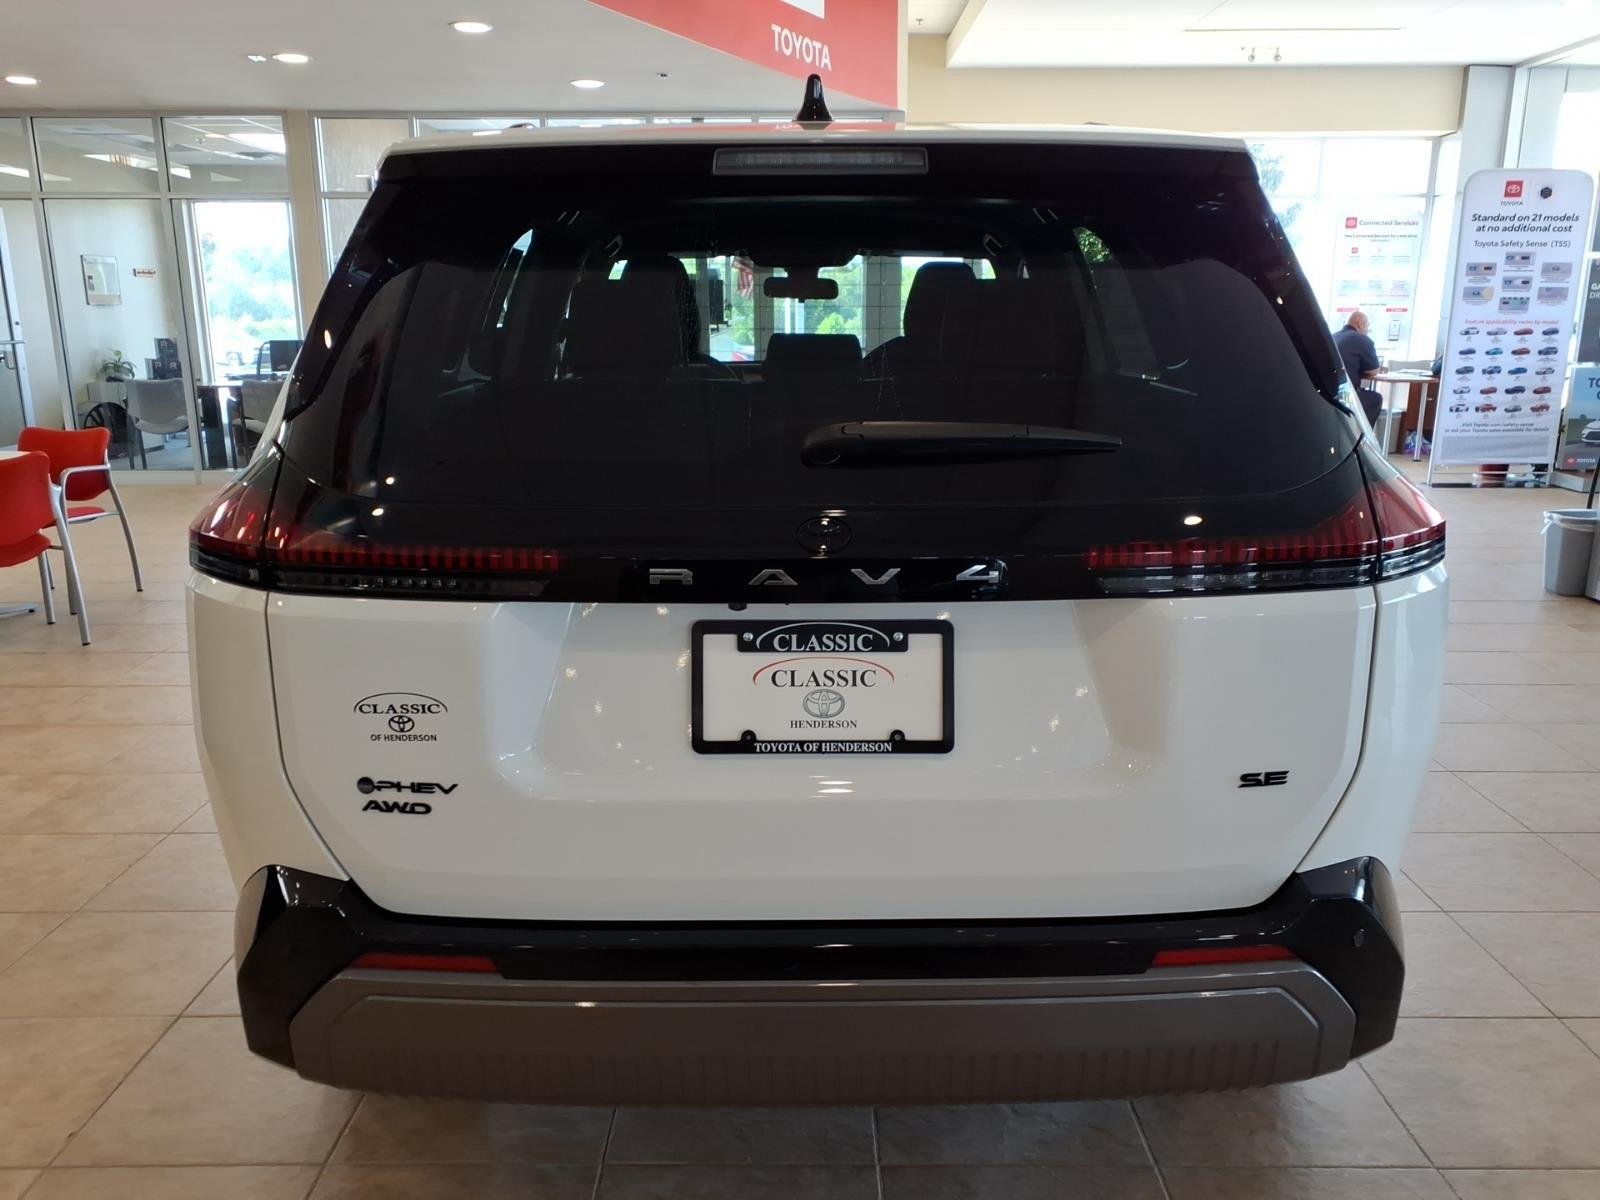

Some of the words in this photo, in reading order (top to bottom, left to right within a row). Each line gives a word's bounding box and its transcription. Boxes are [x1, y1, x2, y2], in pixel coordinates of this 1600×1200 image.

[771, 24, 832, 71] TOYOTA
[1472, 213, 1516, 222] Standard
[1531, 213, 1542, 222] 21
[1543, 213, 1580, 222] models
[1501, 224, 1551, 232] additional
[1552, 224, 1573, 232] cost
[1474, 240, 1499, 248] Toyota
[1500, 240, 1524, 248] Safety
[649, 565, 1000, 586] RAV4
[773, 633, 873, 651] CLASSIC
[771, 669, 876, 687] CLASSIC
[358, 703, 441, 714] CLASSIC
[790, 720, 857, 729] HENDERSON
[754, 742, 802, 752] TOYOTA
[803, 742, 819, 752] OF
[821, 742, 892, 752] HENDERSON
[1238, 770, 1290, 788] SE
[374, 780, 458, 794] PHEV
[362, 800, 432, 814] AWD
